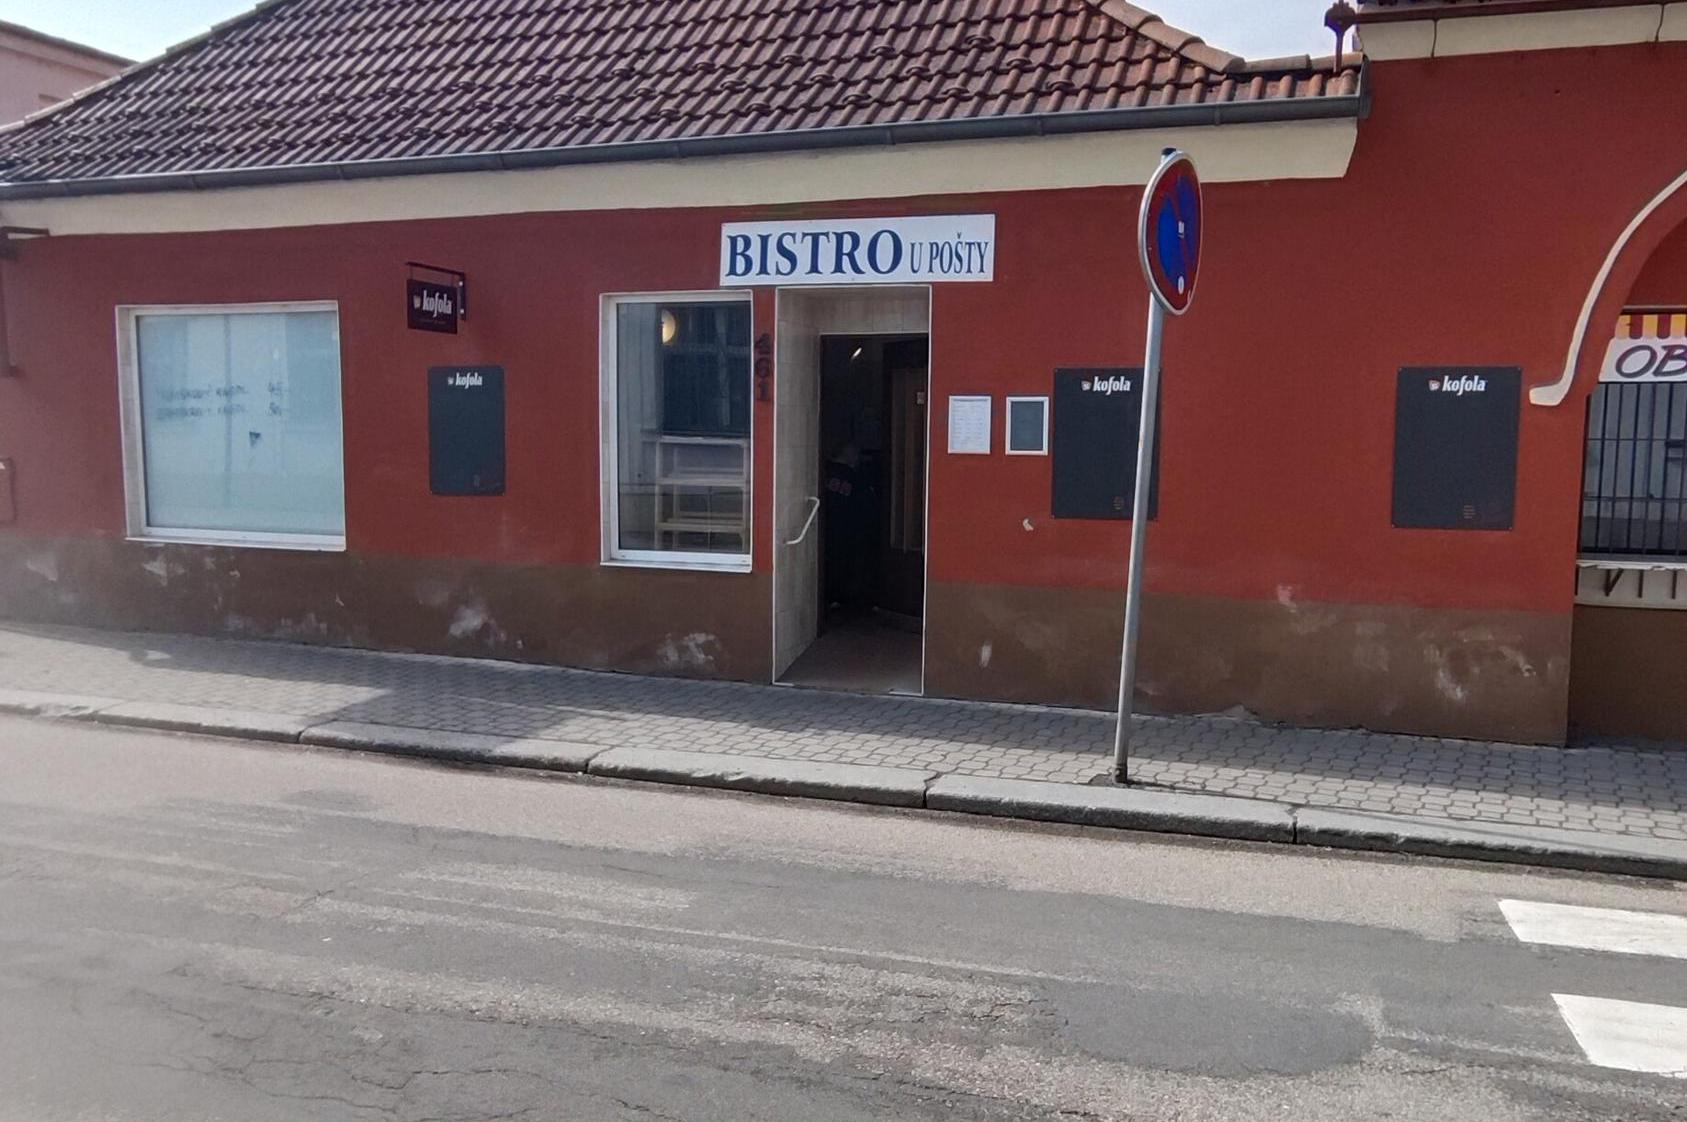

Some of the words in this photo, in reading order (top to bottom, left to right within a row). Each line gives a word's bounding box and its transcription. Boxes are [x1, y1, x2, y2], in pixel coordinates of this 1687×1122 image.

[725, 229, 903, 277] BISTRO
[909, 242, 923, 274] U
[928, 232, 989, 274] POŠTY
[422, 289, 452, 318] kofola
[1615, 344, 1687, 379] OB
[455, 371, 483, 389] kofola
[1093, 376, 1131, 395] kofola
[1442, 375, 1486, 396] kofola
